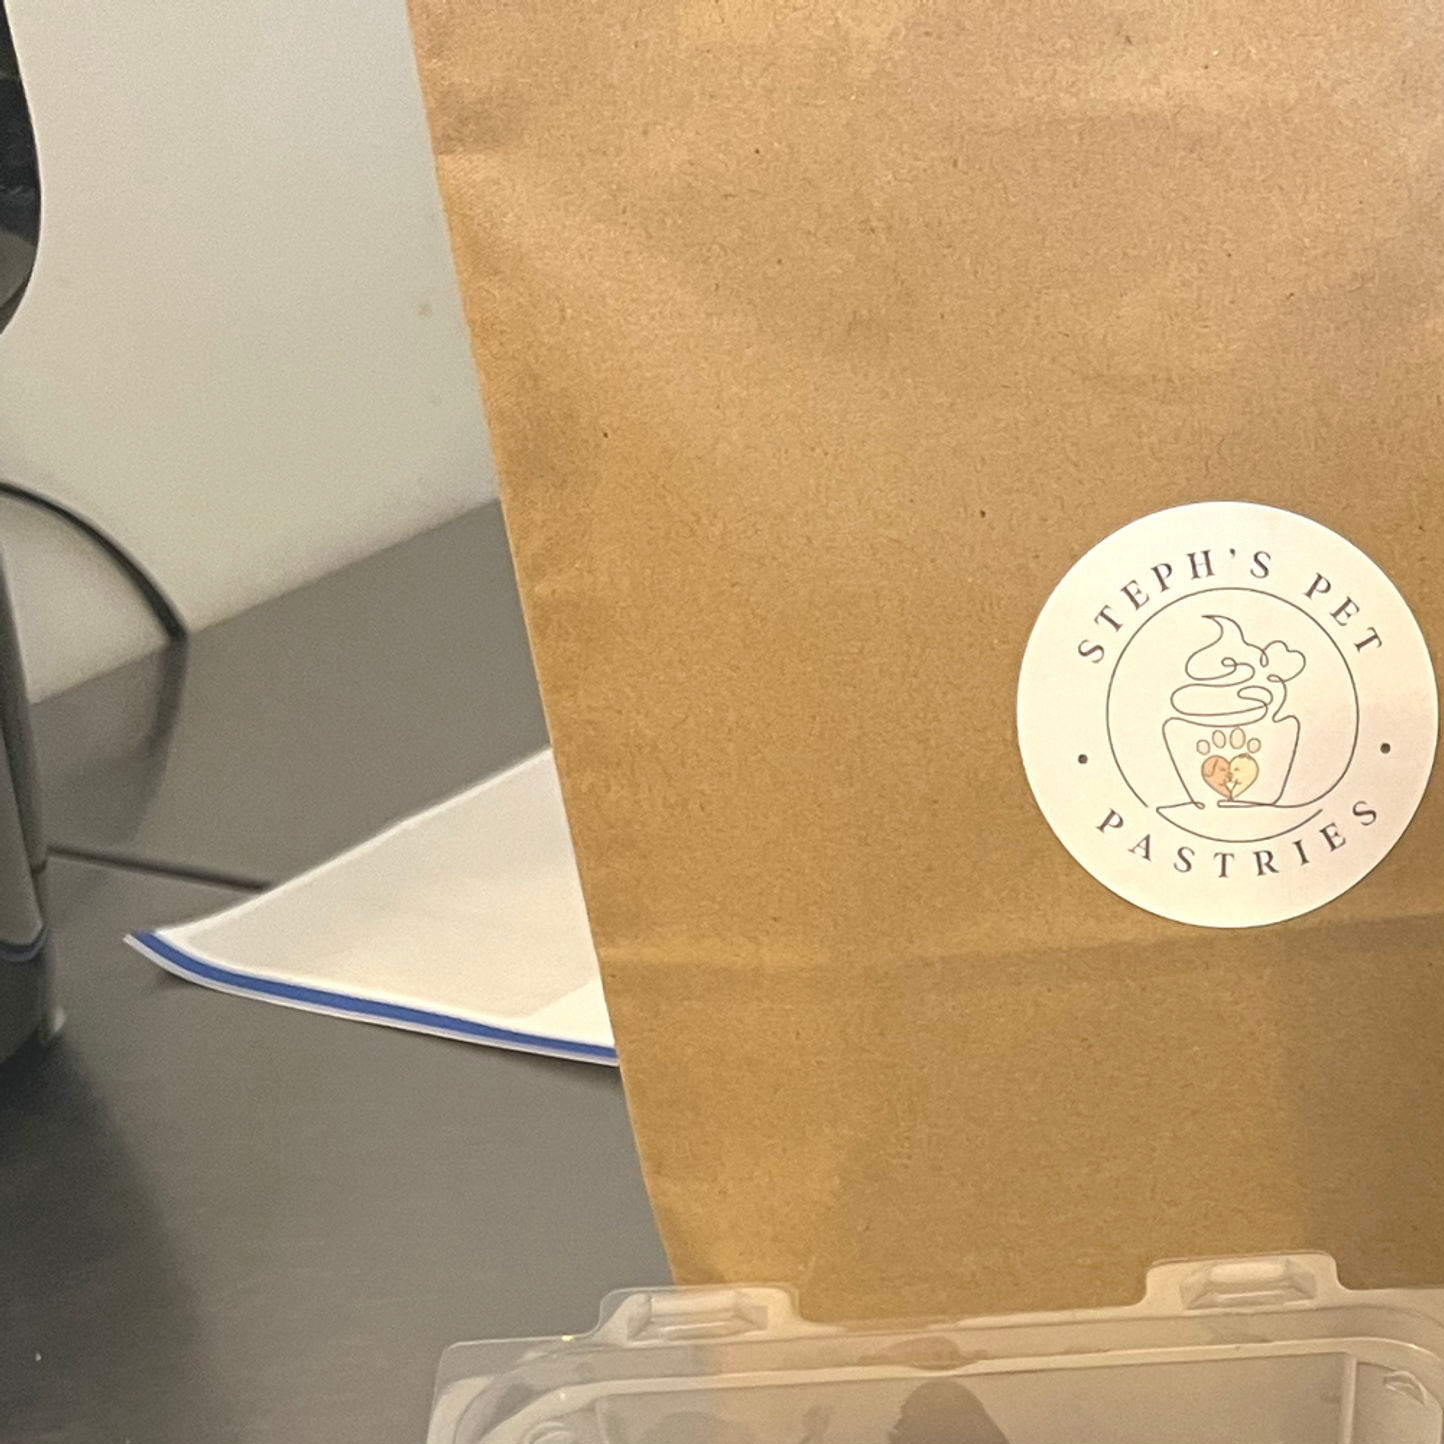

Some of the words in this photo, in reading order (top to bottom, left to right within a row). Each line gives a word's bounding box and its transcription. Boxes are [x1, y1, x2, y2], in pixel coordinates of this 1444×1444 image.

[1078, 548, 1272, 664] STEPH'S
[1305, 573, 1382, 654] PET
[1096, 800, 1378, 878] PASTRIES
